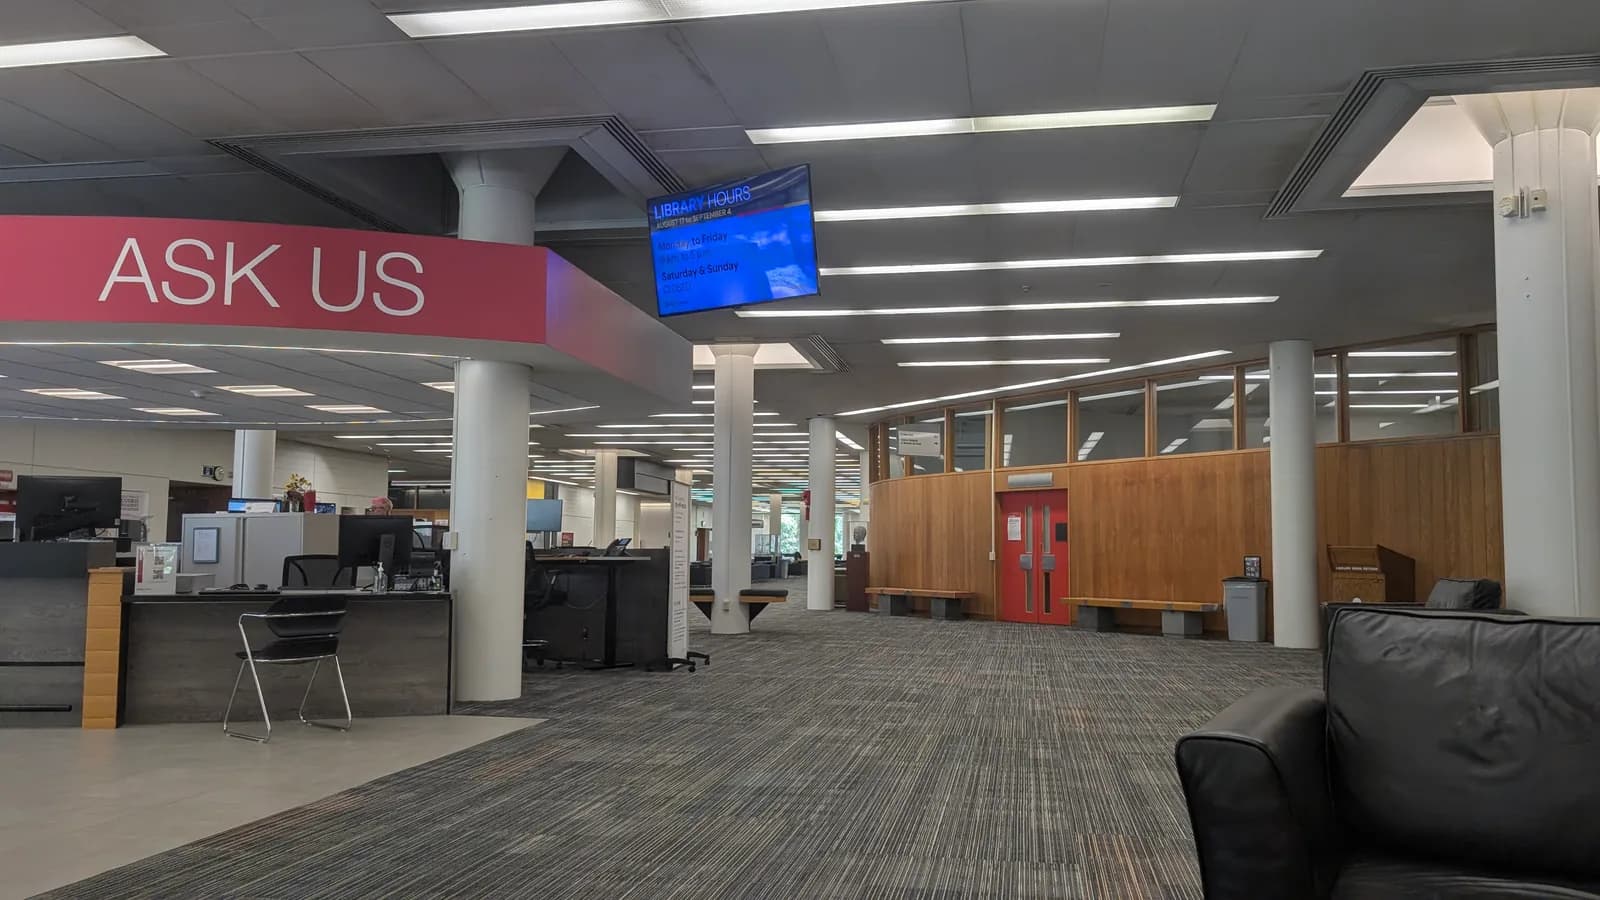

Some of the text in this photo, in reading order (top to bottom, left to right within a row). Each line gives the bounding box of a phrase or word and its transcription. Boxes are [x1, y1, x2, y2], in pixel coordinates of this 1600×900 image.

[654, 185, 751, 219] LIBRARY HOURS
[691, 237, 701, 245] to
[702, 232, 728, 244] Friday
[98, 237, 425, 317] ASK US
[661, 261, 738, 281] Saturday & Sunday
